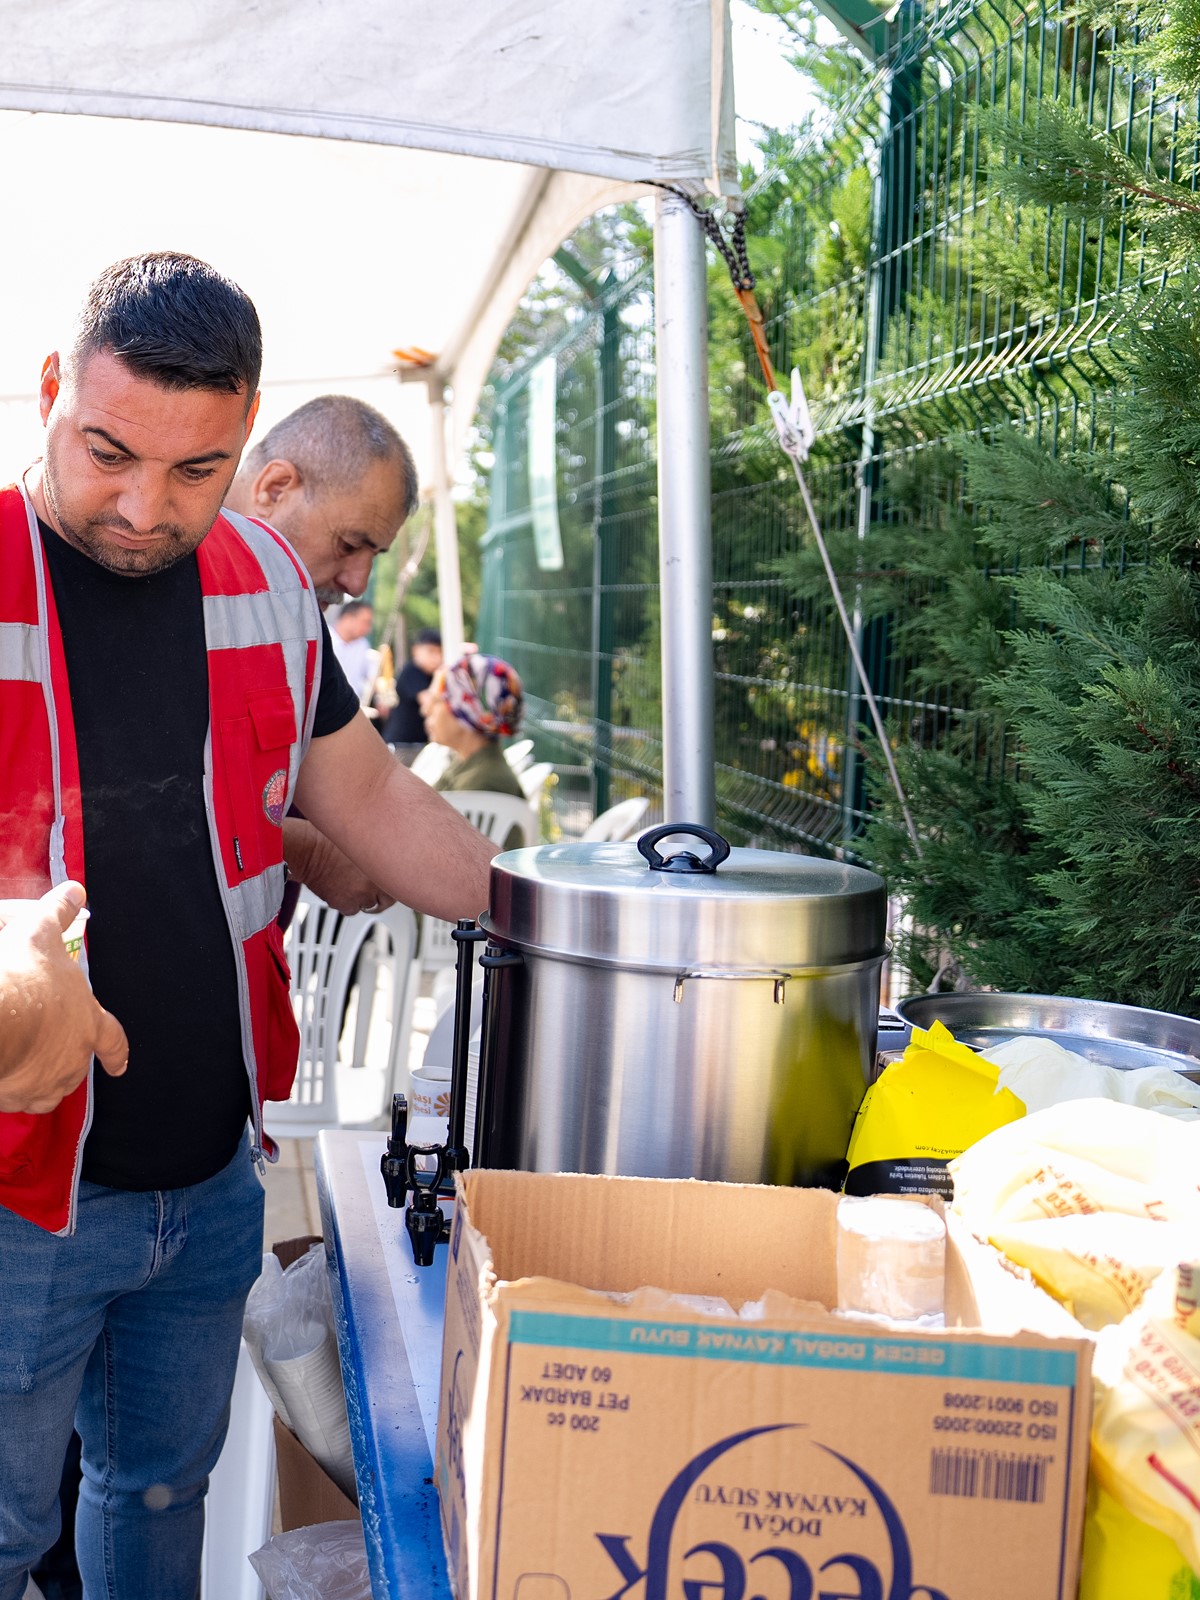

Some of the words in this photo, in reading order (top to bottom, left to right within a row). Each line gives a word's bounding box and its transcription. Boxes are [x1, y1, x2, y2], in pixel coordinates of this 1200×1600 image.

[630, 1327, 690, 1346] SUYU
[697, 1331, 785, 1354] KAYNAK
[542, 1362, 587, 1380] ADET
[591, 1365, 612, 1382] 60
[520, 1385, 592, 1407] BARDAK
[597, 1392, 630, 1410] PET
[943, 1392, 1024, 1414] 9001:2008
[1028, 1399, 1058, 1417] ISO
[570, 1413, 600, 1431] 200
[933, 1415, 1022, 1437] 22000:2005
[1027, 1422, 1057, 1440] ISO
[695, 1483, 761, 1506] SUYU
[766, 1489, 868, 1517] KAYNAK
[737, 1512, 823, 1538] DOĞAL
